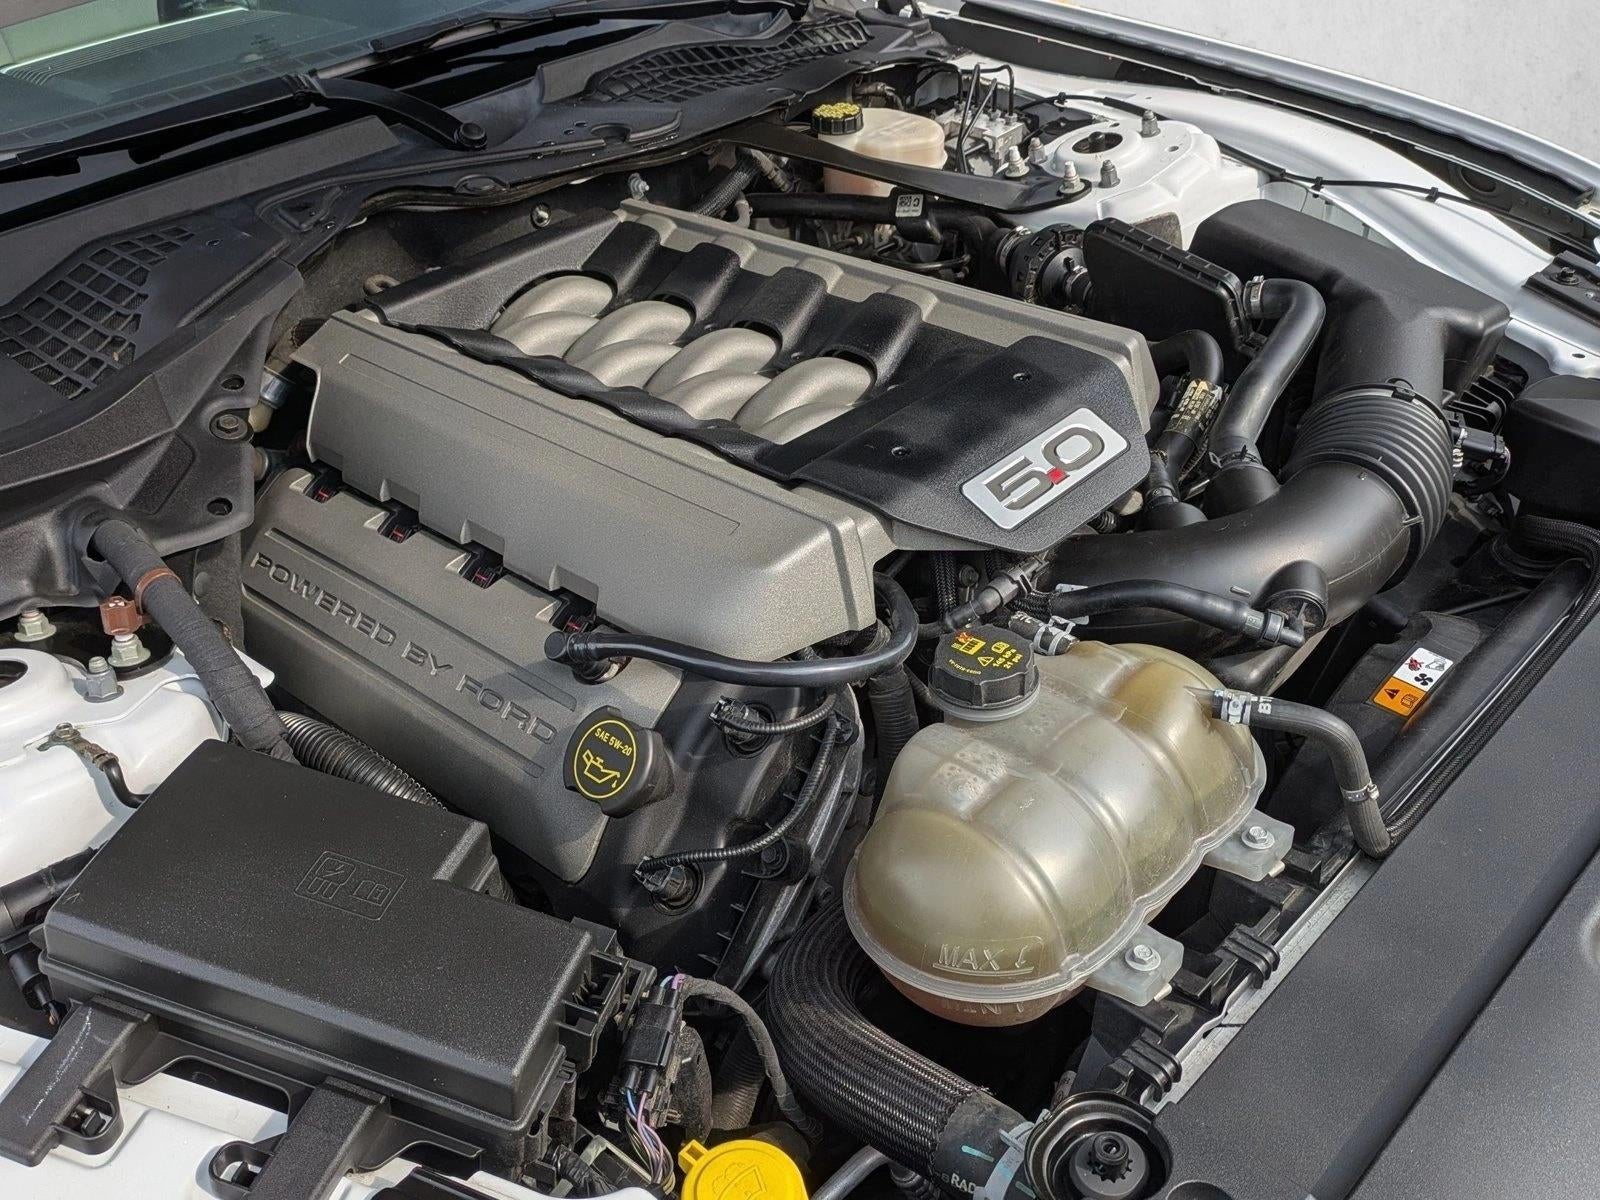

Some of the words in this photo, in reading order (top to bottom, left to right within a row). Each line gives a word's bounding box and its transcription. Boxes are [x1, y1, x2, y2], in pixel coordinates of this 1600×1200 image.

[983, 423, 1106, 512] 5.0
[250, 552, 397, 646] POWERED
[401, 640, 453, 676] BY
[456, 673, 558, 745] FORD
[594, 728, 611, 743] SAE
[608, 736, 633, 757] 5W-20
[938, 943, 1005, 971] MAX
[950, 1172, 977, 1194] RAD
